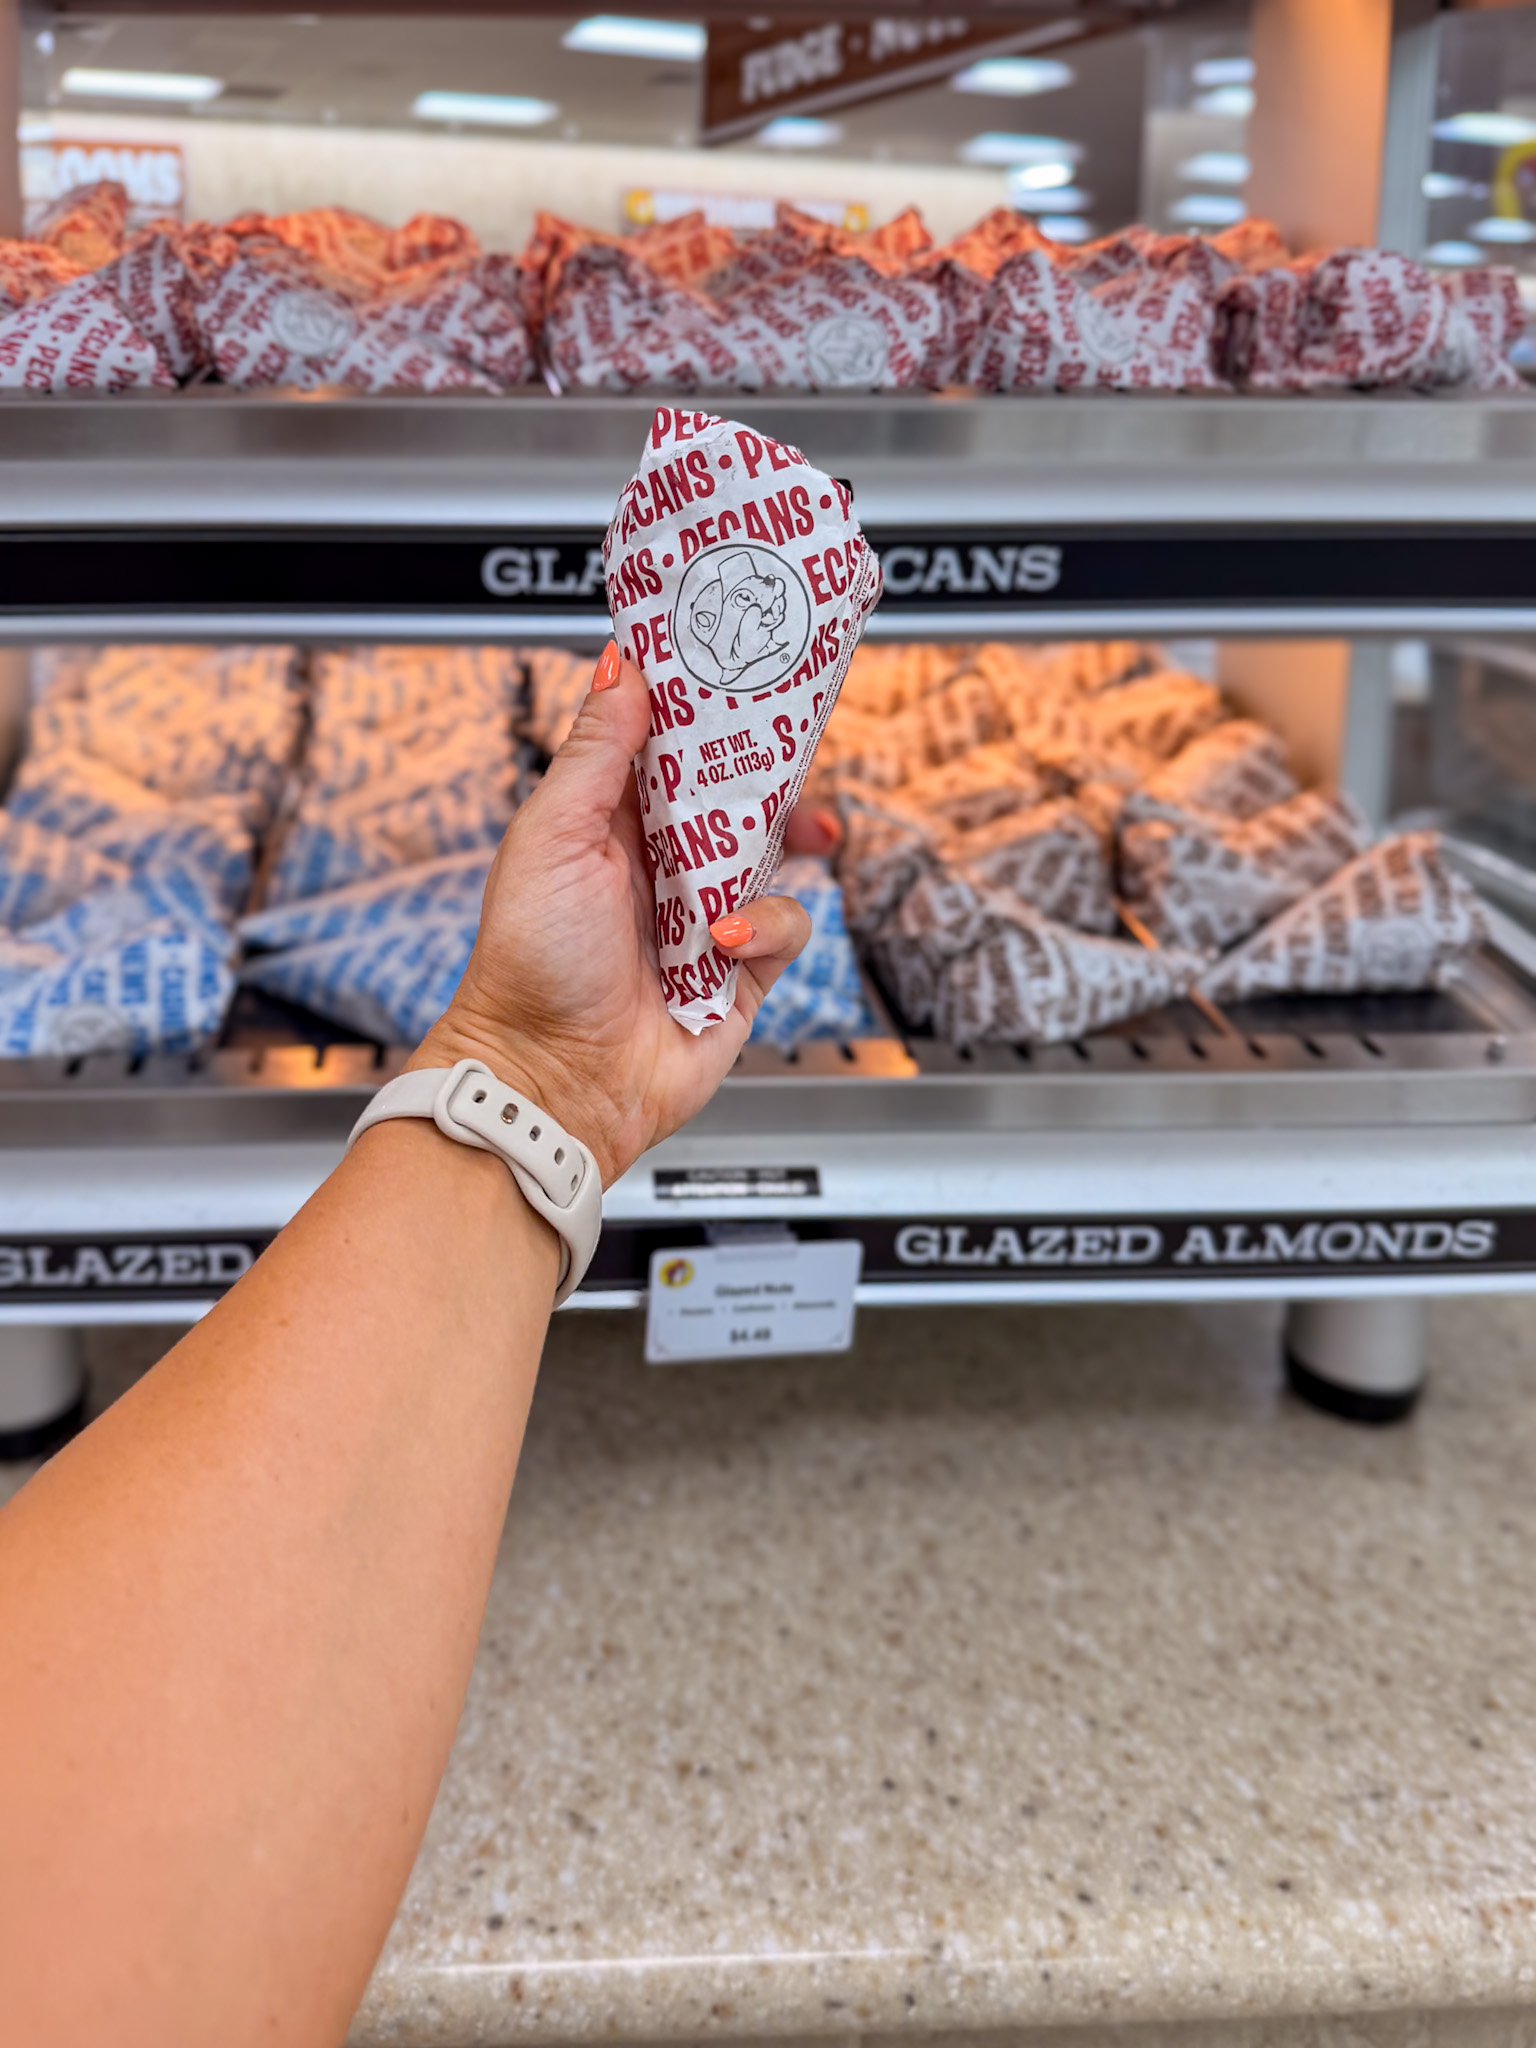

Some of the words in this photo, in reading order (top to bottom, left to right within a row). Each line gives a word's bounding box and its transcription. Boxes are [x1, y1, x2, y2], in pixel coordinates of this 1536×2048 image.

[66, 318, 123, 388] PECANS
[652, 407, 727, 450] PEC
[678, 486, 814, 564] PECANS
[631, 609, 675, 671] PE
[697, 769, 708, 788] 4
[708, 762, 735, 784] OZ.
[733, 746, 775, 777] (113g)
[699, 738, 728, 763] NET
[727, 729, 758, 754] WT.
[660, 945, 738, 1006] PECAN
[896, 1225, 1162, 1266] GLAZED
[1173, 1219, 1497, 1264] ALMONDS
